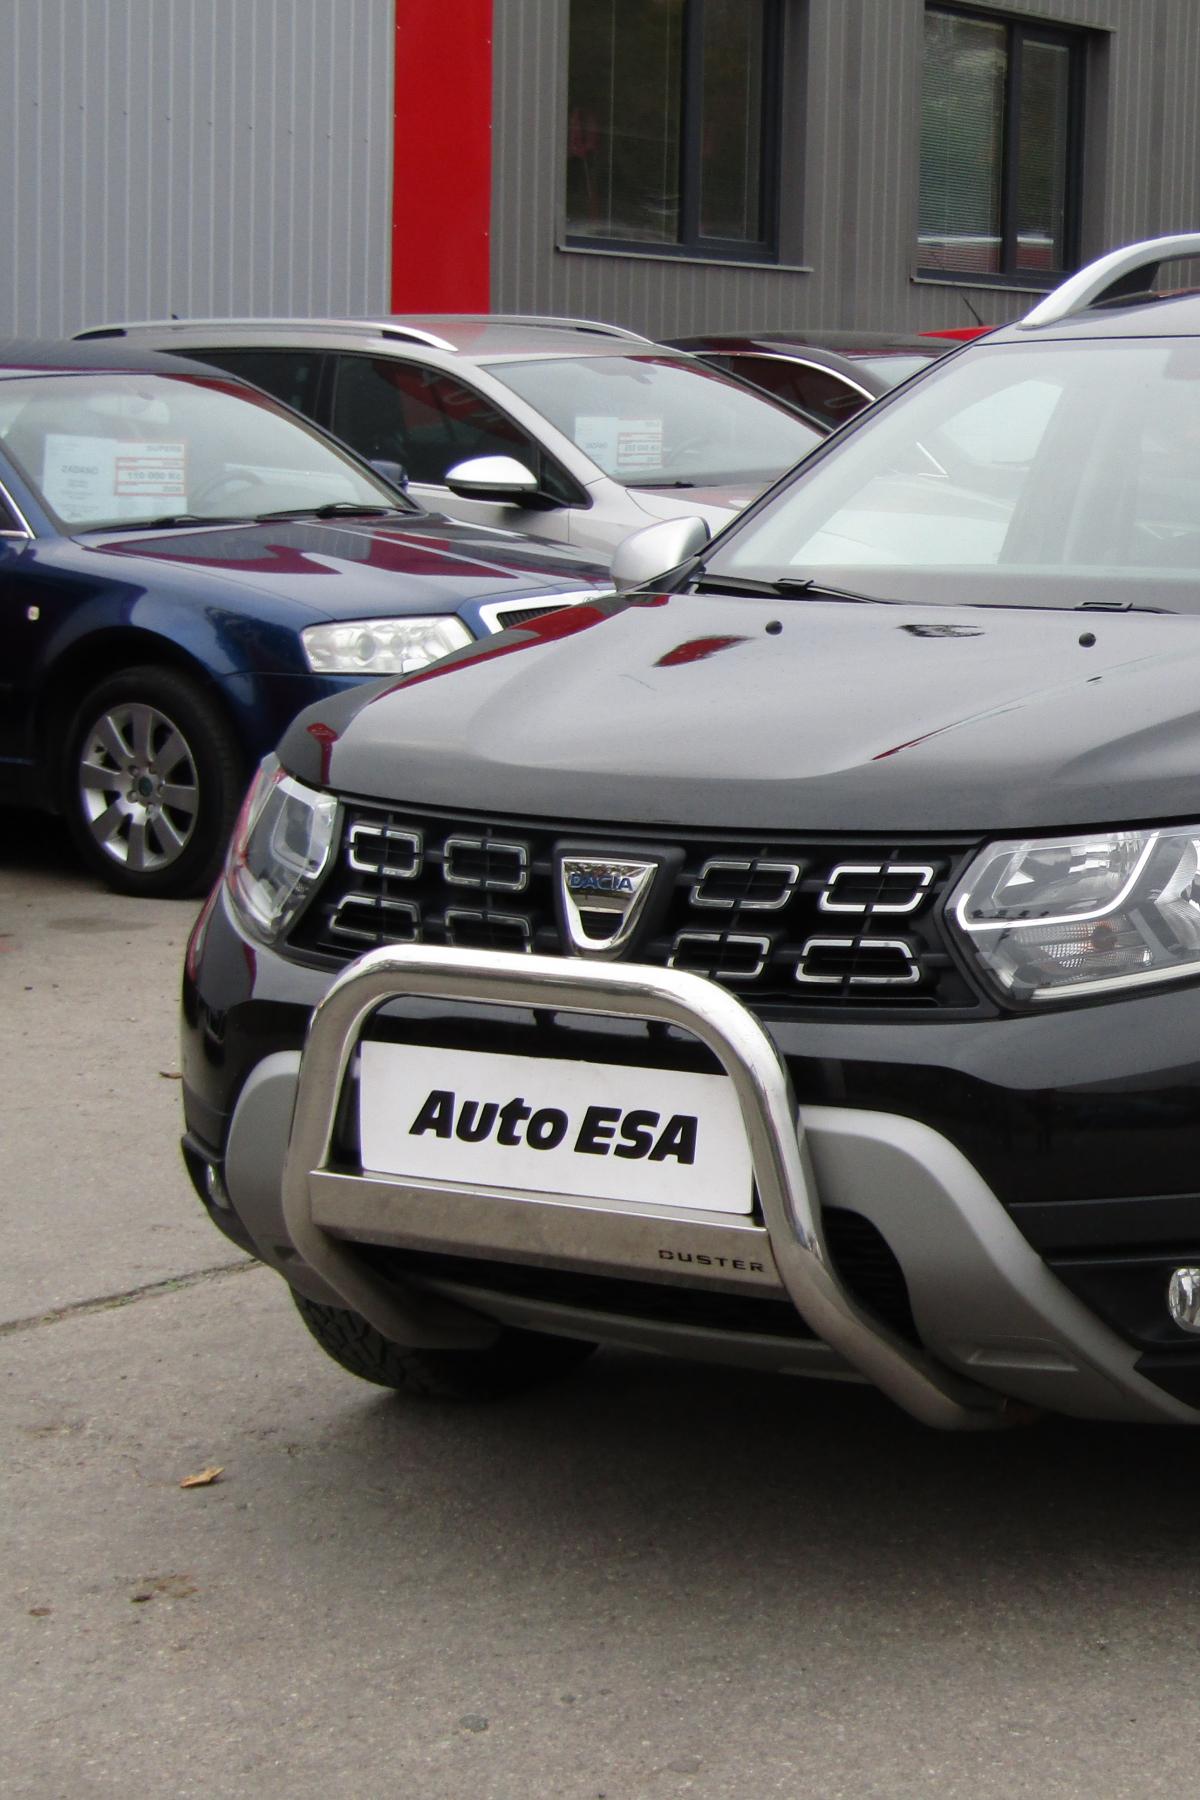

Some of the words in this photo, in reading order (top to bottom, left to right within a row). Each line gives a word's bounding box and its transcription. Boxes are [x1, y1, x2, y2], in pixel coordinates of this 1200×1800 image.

[569, 873, 634, 892] DACIA
[408, 1090, 569, 1151] Auto
[573, 1105, 699, 1166] ESA
[658, 1250, 765, 1273] DUSTER
